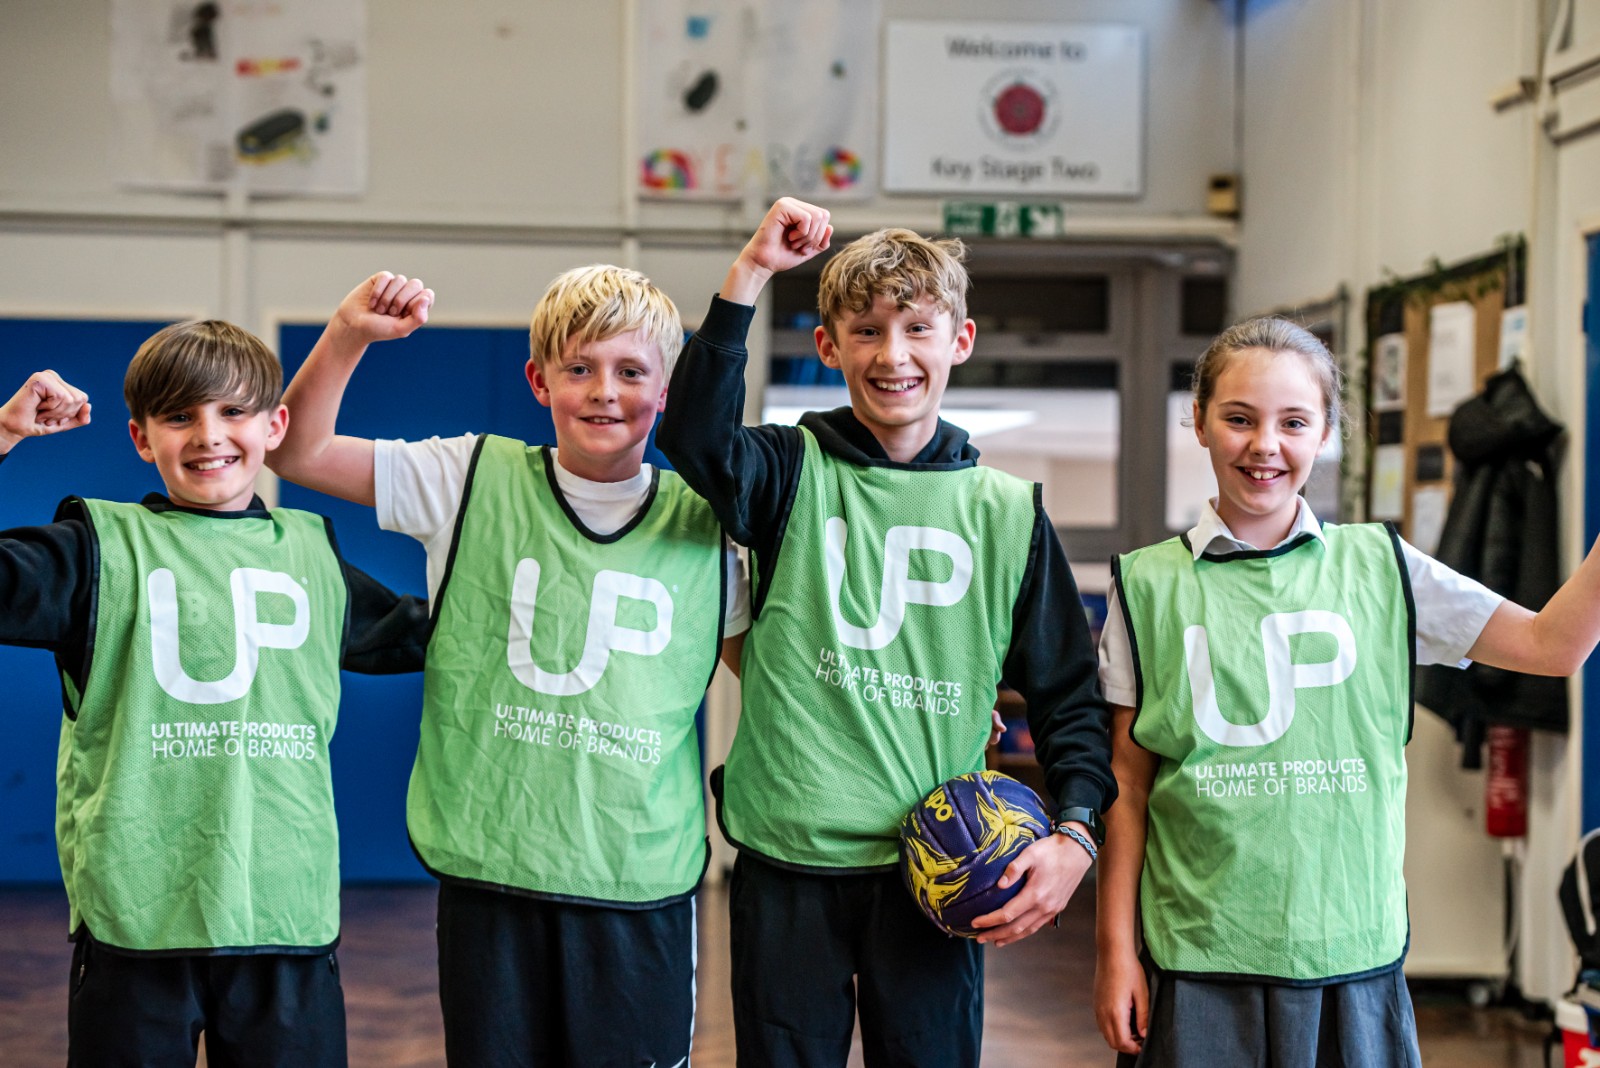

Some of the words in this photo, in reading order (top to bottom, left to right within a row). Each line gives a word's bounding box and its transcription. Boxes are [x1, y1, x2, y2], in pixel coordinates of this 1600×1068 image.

[946, 36, 1053, 59] Welcome
[1060, 39, 1086, 61] to
[931, 156, 972, 183] Key
[980, 154, 1045, 184] Stage
[1051, 155, 1098, 181] Two
[825, 516, 974, 650] UP
[147, 567, 311, 704] UP
[507, 557, 674, 696] UP
[882, 671, 962, 697] PRODUCTS
[1184, 610, 1357, 747] UP
[863, 684, 888, 704] OF
[892, 689, 960, 716] BRANDS
[151, 721, 240, 739] ULTIMATE
[241, 722, 317, 740] PRODUCTS
[496, 703, 575, 729] ULTIMATE
[578, 717, 662, 746] PRODUCTS
[152, 739, 217, 758] HOME
[247, 739, 316, 760] BRANDS
[494, 719, 553, 745] HOME
[558, 730, 583, 750] OF
[587, 735, 662, 765] BRANDS
[1195, 761, 1278, 779] ULTIMATE
[1282, 758, 1367, 776] PRODUCTS
[1196, 779, 1257, 798] HOME
[1264, 777, 1289, 796] OF
[1296, 775, 1368, 795] BRANDS
